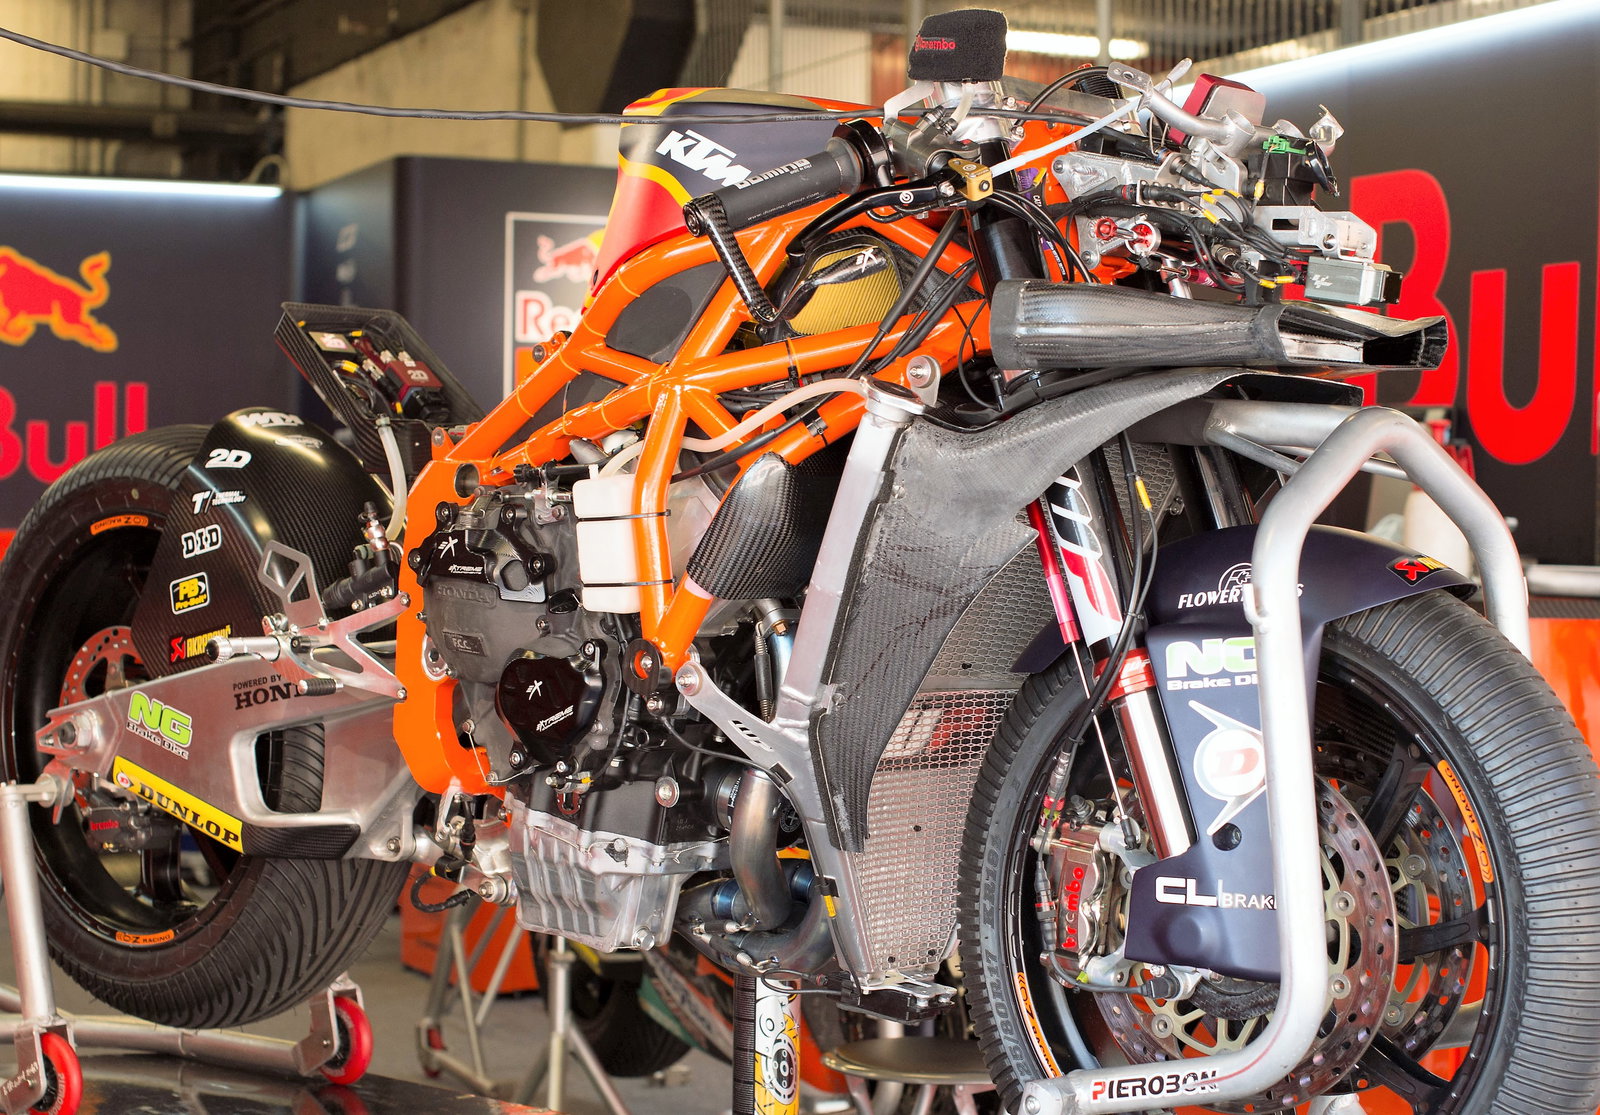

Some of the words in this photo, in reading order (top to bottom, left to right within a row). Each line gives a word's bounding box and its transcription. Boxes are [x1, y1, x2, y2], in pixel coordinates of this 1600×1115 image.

[920, 37, 956, 51] brembo
[655, 129, 752, 188] KTM
[734, 158, 811, 190] domino
[1344, 168, 1600, 466] Bu
[407, 369, 429, 382] 2D
[205, 448, 252, 469] 2D
[181, 524, 222, 558] DID
[178, 577, 200, 601] PB
[233, 676, 268, 690] POWERED
[270, 674, 282, 684] BY
[234, 682, 303, 711] HON
[1167, 676, 1232, 691] Brake
[128, 691, 192, 747] NG
[126, 721, 162, 747] Brake
[161, 740, 190, 760] Disc
[1444, 767, 1476, 824] RACING
[90, 820, 120, 831] brembo
[137, 782, 240, 845] DUNLOP
[1472, 831, 1490, 868] OZ
[1061, 866, 1085, 949] brembo
[1155, 876, 1218, 908] CL
[142, 934, 171, 943] RACING
[1092, 1069, 1218, 1101] PIEROBON
